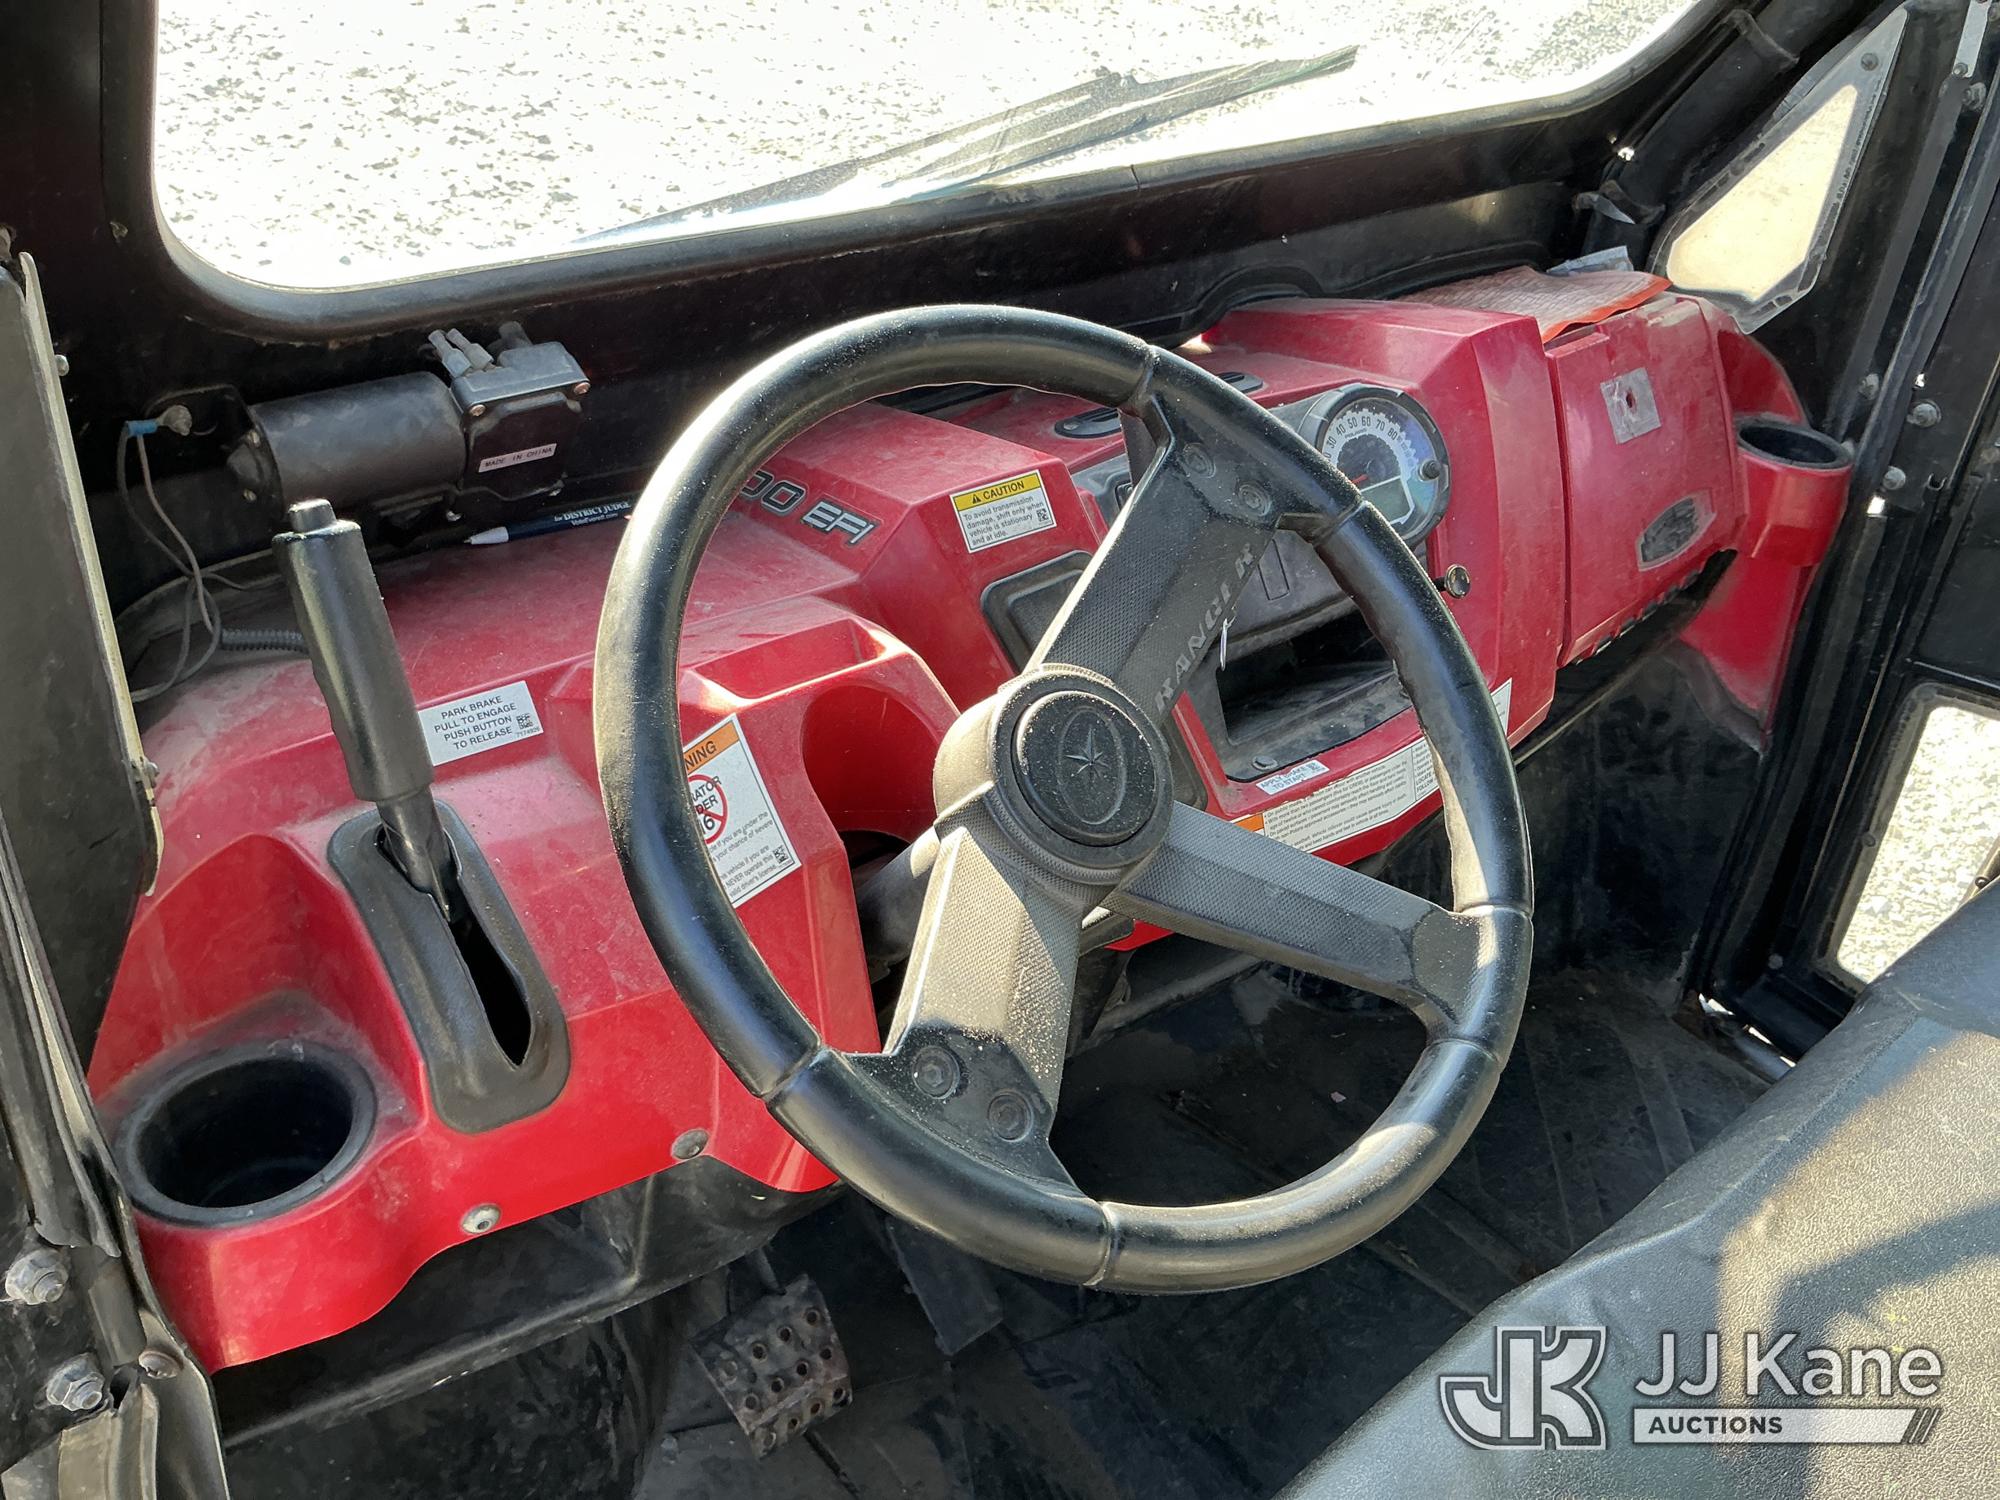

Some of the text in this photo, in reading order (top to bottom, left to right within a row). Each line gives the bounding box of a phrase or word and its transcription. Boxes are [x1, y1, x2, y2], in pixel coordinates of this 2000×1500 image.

[1336, 424, 1346, 436] 40
[1347, 417, 1358, 429] 50
[1361, 416, 1371, 427] 60
[1375, 419, 1386, 432] 70
[1326, 436, 1337, 449] 30
[1387, 428, 1398, 440] 80
[485, 457, 506, 467] MADE
[526, 447, 552, 458] CHINA
[983, 480, 1025, 500] CAUTION
[563, 506, 603, 521] DISTRICT
[603, 501, 631, 514] JUDGE
[963, 496, 1034, 521] To avoid transmission
[966, 502, 1044, 530] damage, shift only when
[969, 527, 993, 538] vehicle
[1001, 513, 1033, 528] stationary
[971, 530, 1008, 546] and at idle.
[441, 695, 503, 719] PARK BRAKE
[434, 703, 517, 733] PULL TO ENGAGE
[444, 715, 512, 741] PUSH BUTTON
[453, 726, 512, 750] TO RELEASE
[691, 775, 722, 802] ATOR
[703, 815, 716, 831] 6
